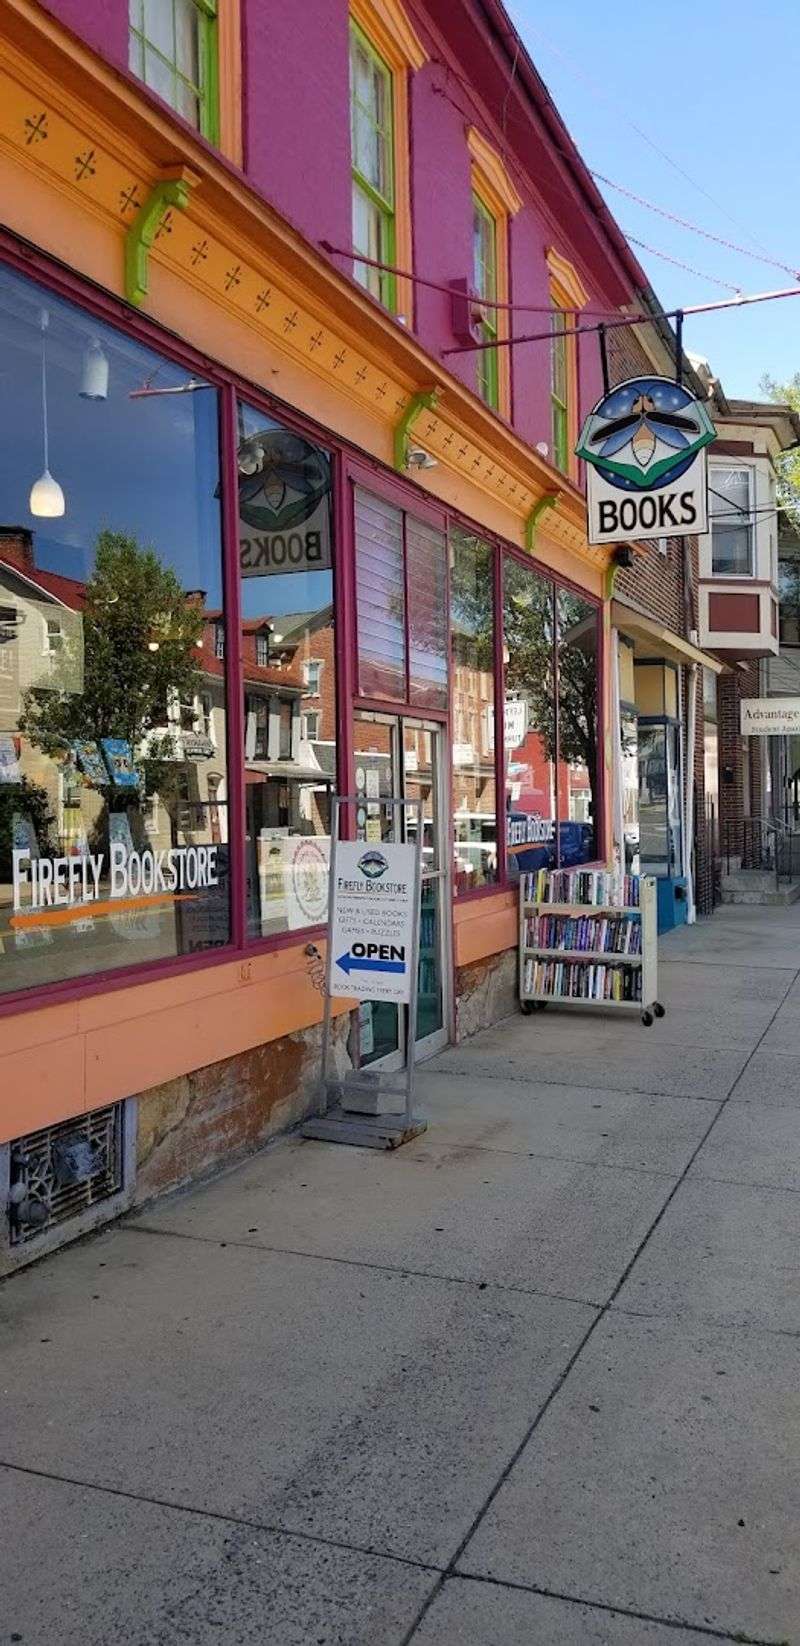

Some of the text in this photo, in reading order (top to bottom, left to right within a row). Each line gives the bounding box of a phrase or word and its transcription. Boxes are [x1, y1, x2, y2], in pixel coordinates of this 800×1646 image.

[598, 491, 697, 533] BOOKS
[744, 709, 800, 722] Advantage
[13, 842, 219, 910] FIREFLY BOOKSTORE
[366, 879, 407, 895] BOOKSTORE
[351, 942, 405, 961] OPEN
